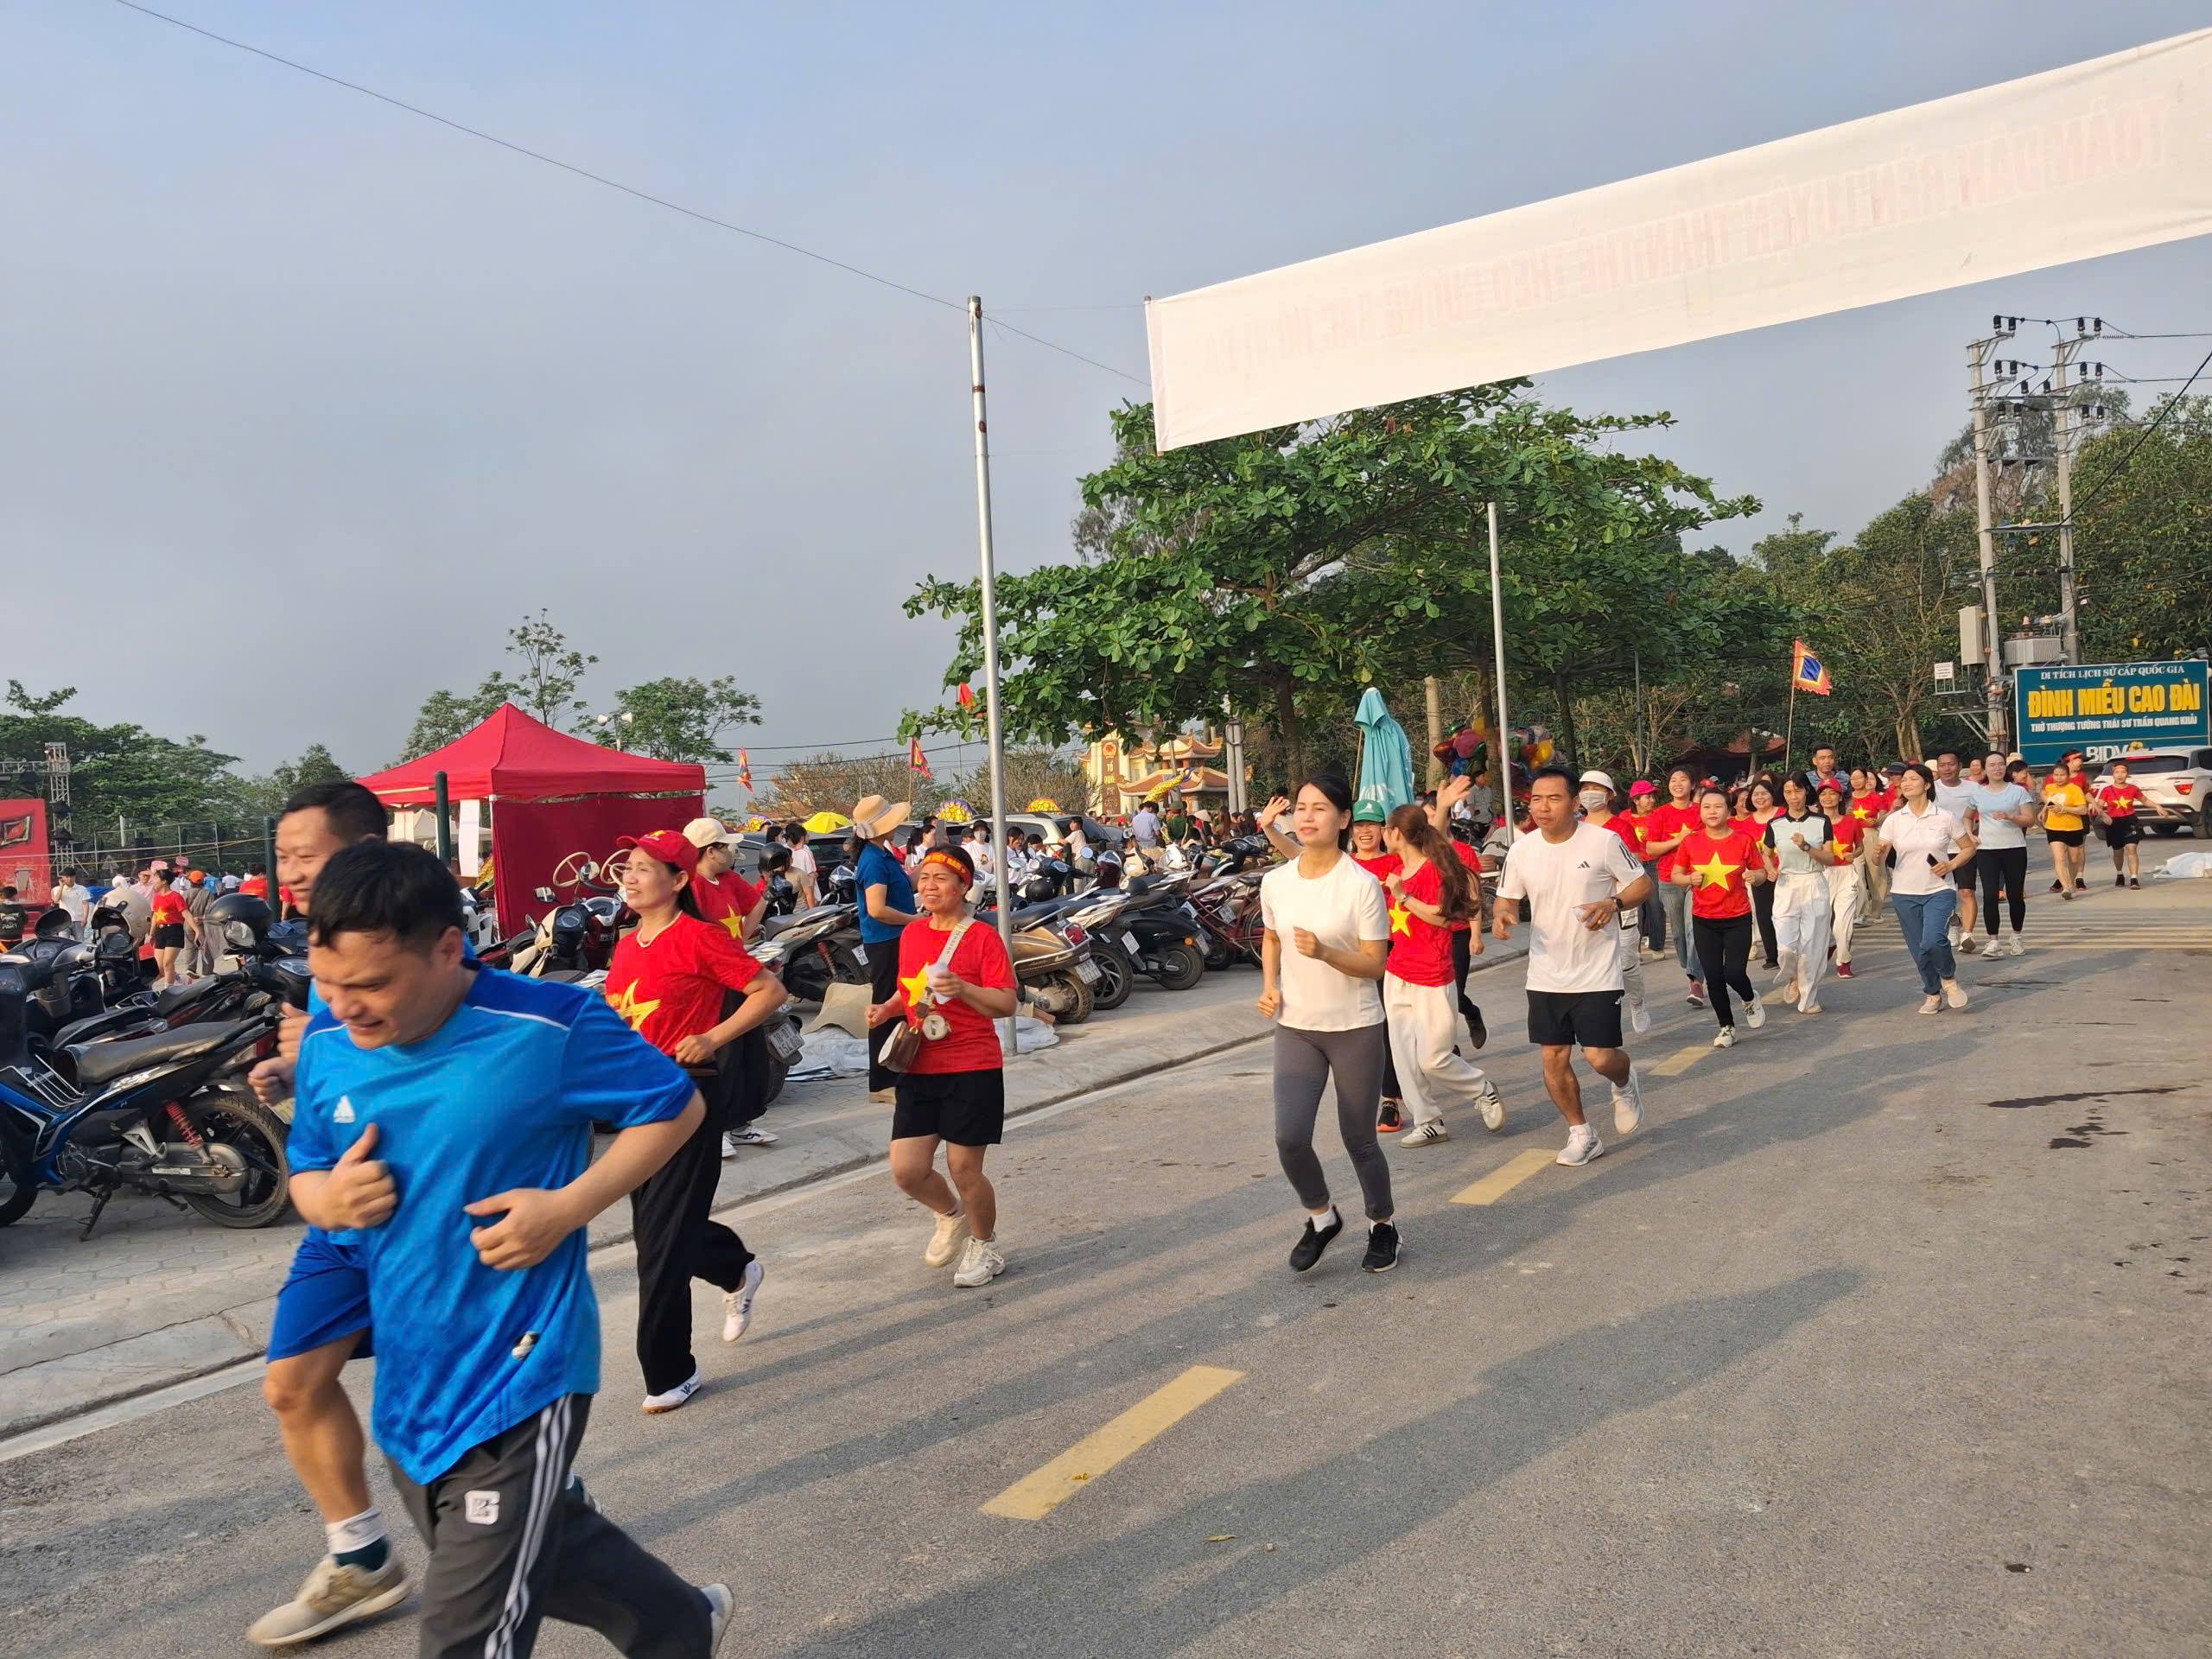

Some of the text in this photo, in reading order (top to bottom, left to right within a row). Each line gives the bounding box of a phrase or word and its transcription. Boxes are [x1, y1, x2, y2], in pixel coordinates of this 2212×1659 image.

[2052, 668, 2075, 679] TÍCH
[2078, 669, 2101, 679] LỊCH
[2117, 663, 2136, 676] CẤP
[2138, 664, 2165, 676] QUỐC
[2166, 664, 2184, 673] GIA
[2028, 684, 2073, 718] ĐÌNH
[2128, 683, 2165, 713] CAO
[2169, 678, 2200, 711] ĐÀI
[2086, 745, 2129, 762] BIDV
